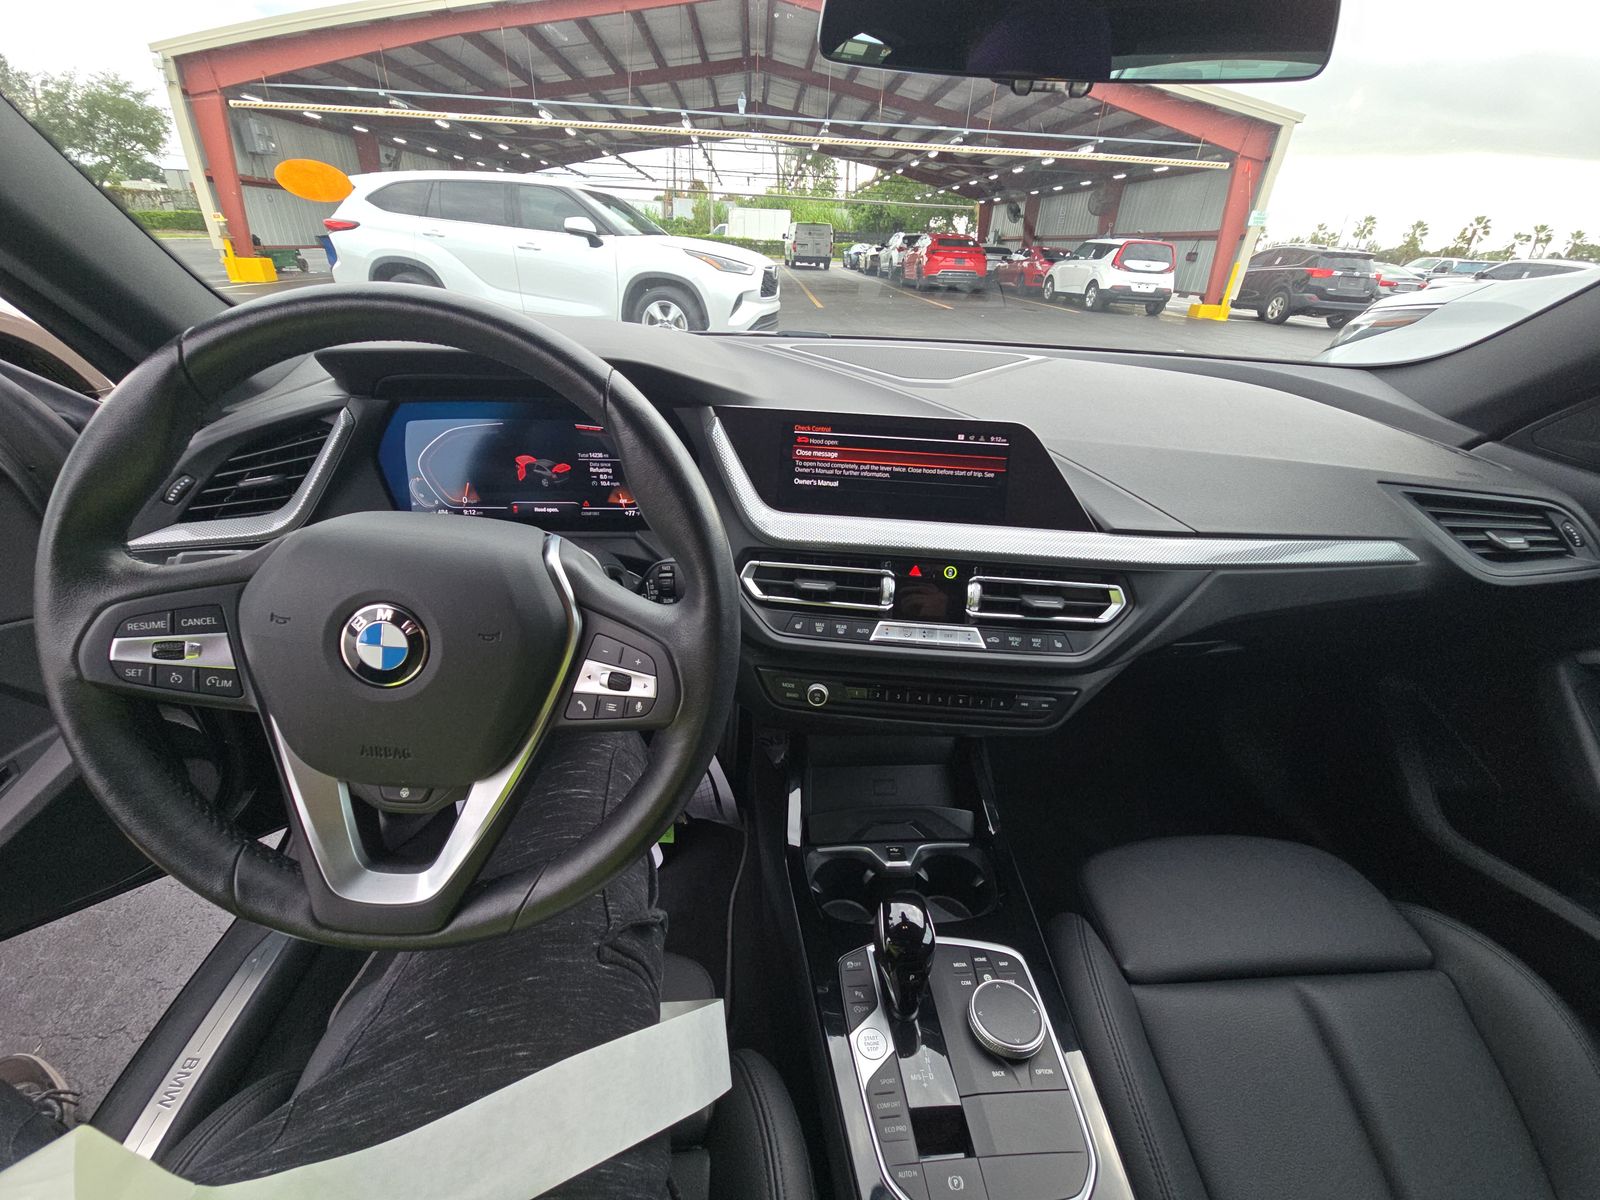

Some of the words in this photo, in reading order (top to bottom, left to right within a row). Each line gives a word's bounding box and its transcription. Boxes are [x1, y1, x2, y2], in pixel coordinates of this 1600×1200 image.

[794, 424, 811, 432] Check
[811, 425, 832, 433] Control
[796, 449, 812, 457] Close
[813, 451, 839, 459] message
[127, 620, 168, 631] RESUME
[180, 616, 218, 627] CANCEL
[351, 608, 419, 636] BMW
[125, 668, 143, 677] SET
[216, 679, 233, 688] LIM
[158, 1057, 201, 1109] BMW
[876, 1101, 900, 1110] COMFORT
[884, 1126, 896, 1134] ECO
[898, 1170, 912, 1178] AUTO
